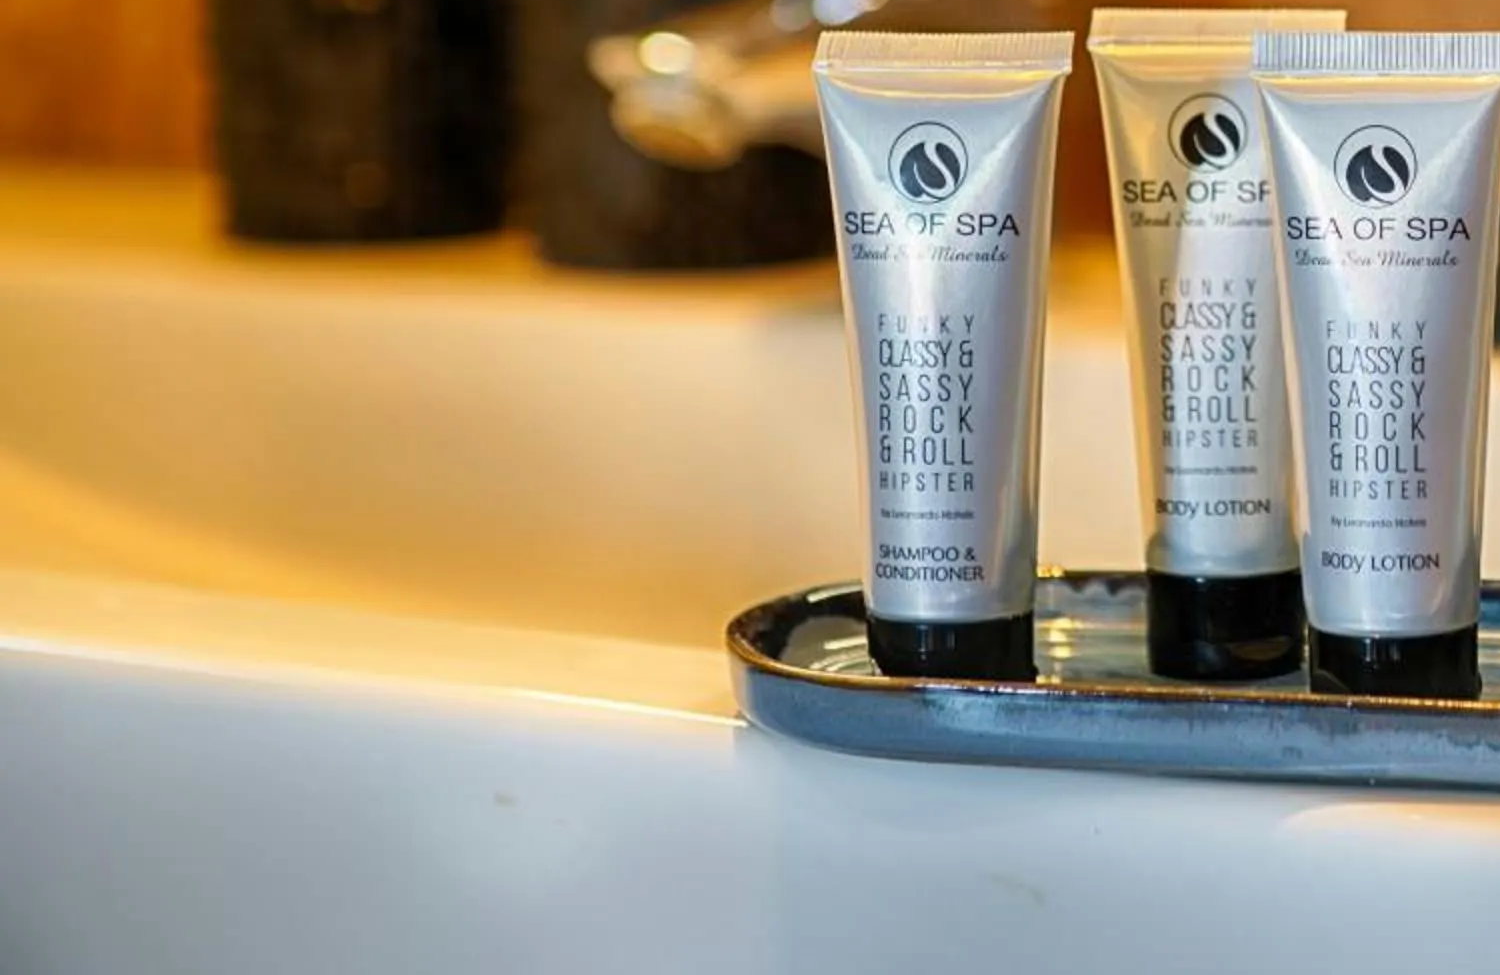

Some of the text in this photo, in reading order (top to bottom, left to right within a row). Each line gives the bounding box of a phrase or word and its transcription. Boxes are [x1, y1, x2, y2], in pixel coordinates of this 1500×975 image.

[1123, 180, 1271, 204] SEA OF SP
[844, 211, 1020, 236] SEA OF SPA
[1287, 216, 1343, 240] SEA
[1353, 217, 1398, 241] OF
[1406, 217, 1471, 241] SPA
[1159, 277, 1257, 297] FUNKY
[1160, 301, 1256, 330] CLASSY &
[1326, 320, 1427, 340] FUNKY
[879, 338, 973, 369] CLASSY &
[1160, 334, 1256, 363] SASSY
[1327, 345, 1425, 374] CLASSY &
[879, 372, 973, 401] SASSY
[1161, 365, 1256, 393] ROCK
[1328, 379, 1425, 409] SASSY
[879, 403, 974, 434] ROCK
[1162, 395, 1257, 423] & ROLL
[1161, 428, 1258, 448] HIPSTER
[1329, 411, 1426, 441] ROCK
[880, 435, 973, 465] & ROLL
[1330, 442, 1427, 473] & ROLL
[879, 471, 974, 492] HIPSTER
[1329, 479, 1427, 501] HIPSTER
[1205, 498, 1271, 516] LOTION
[879, 544, 977, 562] SHAMPOO &
[1371, 552, 1440, 571] LOTION
[875, 562, 985, 581] CONDITIONER
